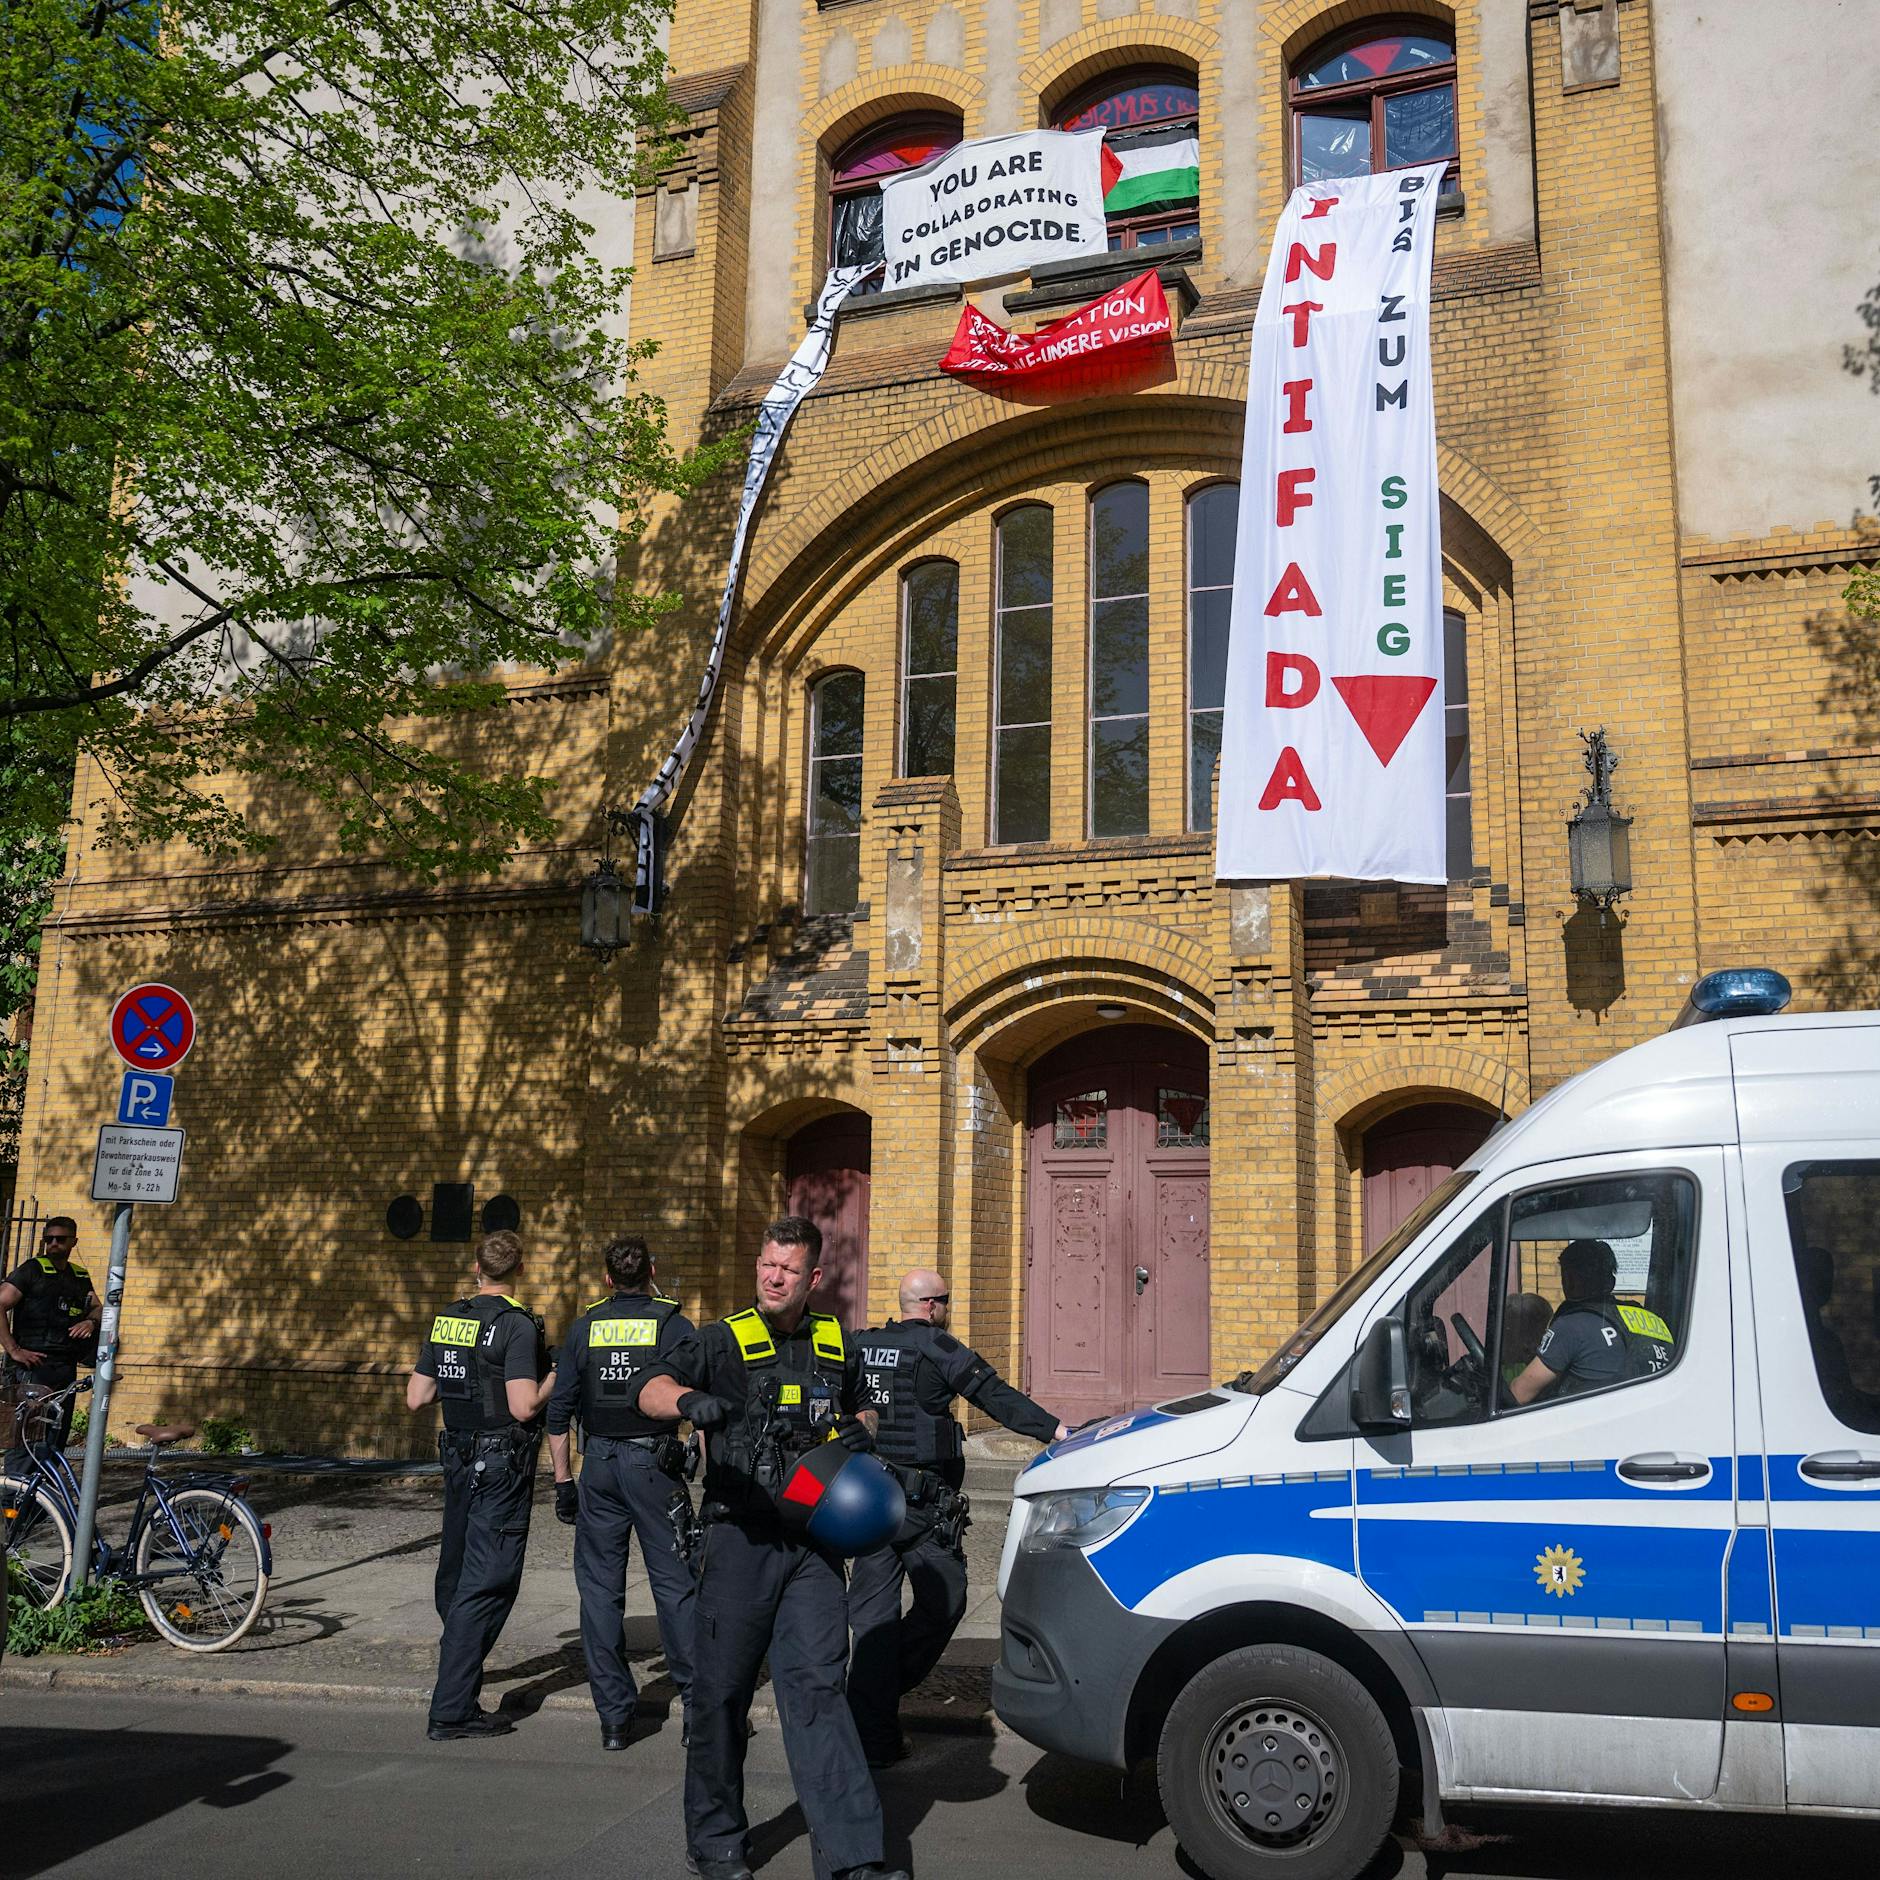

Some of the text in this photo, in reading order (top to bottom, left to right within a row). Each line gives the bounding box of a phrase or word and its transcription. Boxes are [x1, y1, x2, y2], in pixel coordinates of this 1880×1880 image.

[930, 151, 1042, 203] YOU ARE
[902, 188, 1078, 243] COLLABORATING
[894, 218, 1086, 284] IN GENOCIDE.
[1108, 316, 1170, 343] VISION
[1376, 176, 1425, 657] BIS ZUM SIEG
[1258, 197, 1339, 812] INTIFADA
[127, 1078, 157, 1118] P
[105, 1136, 176, 1148] mit Parkschein oder
[100, 1150, 176, 1163] Bewohnerparkausweis
[109, 1166, 164, 1177] für die Zone 34
[433, 1319, 477, 1345] POLIZEI
[591, 1321, 655, 1344] POLIZEI
[444, 1350, 458, 1364] BE
[611, 1351, 630, 1366] BE
[437, 1365, 466, 1379] 25129
